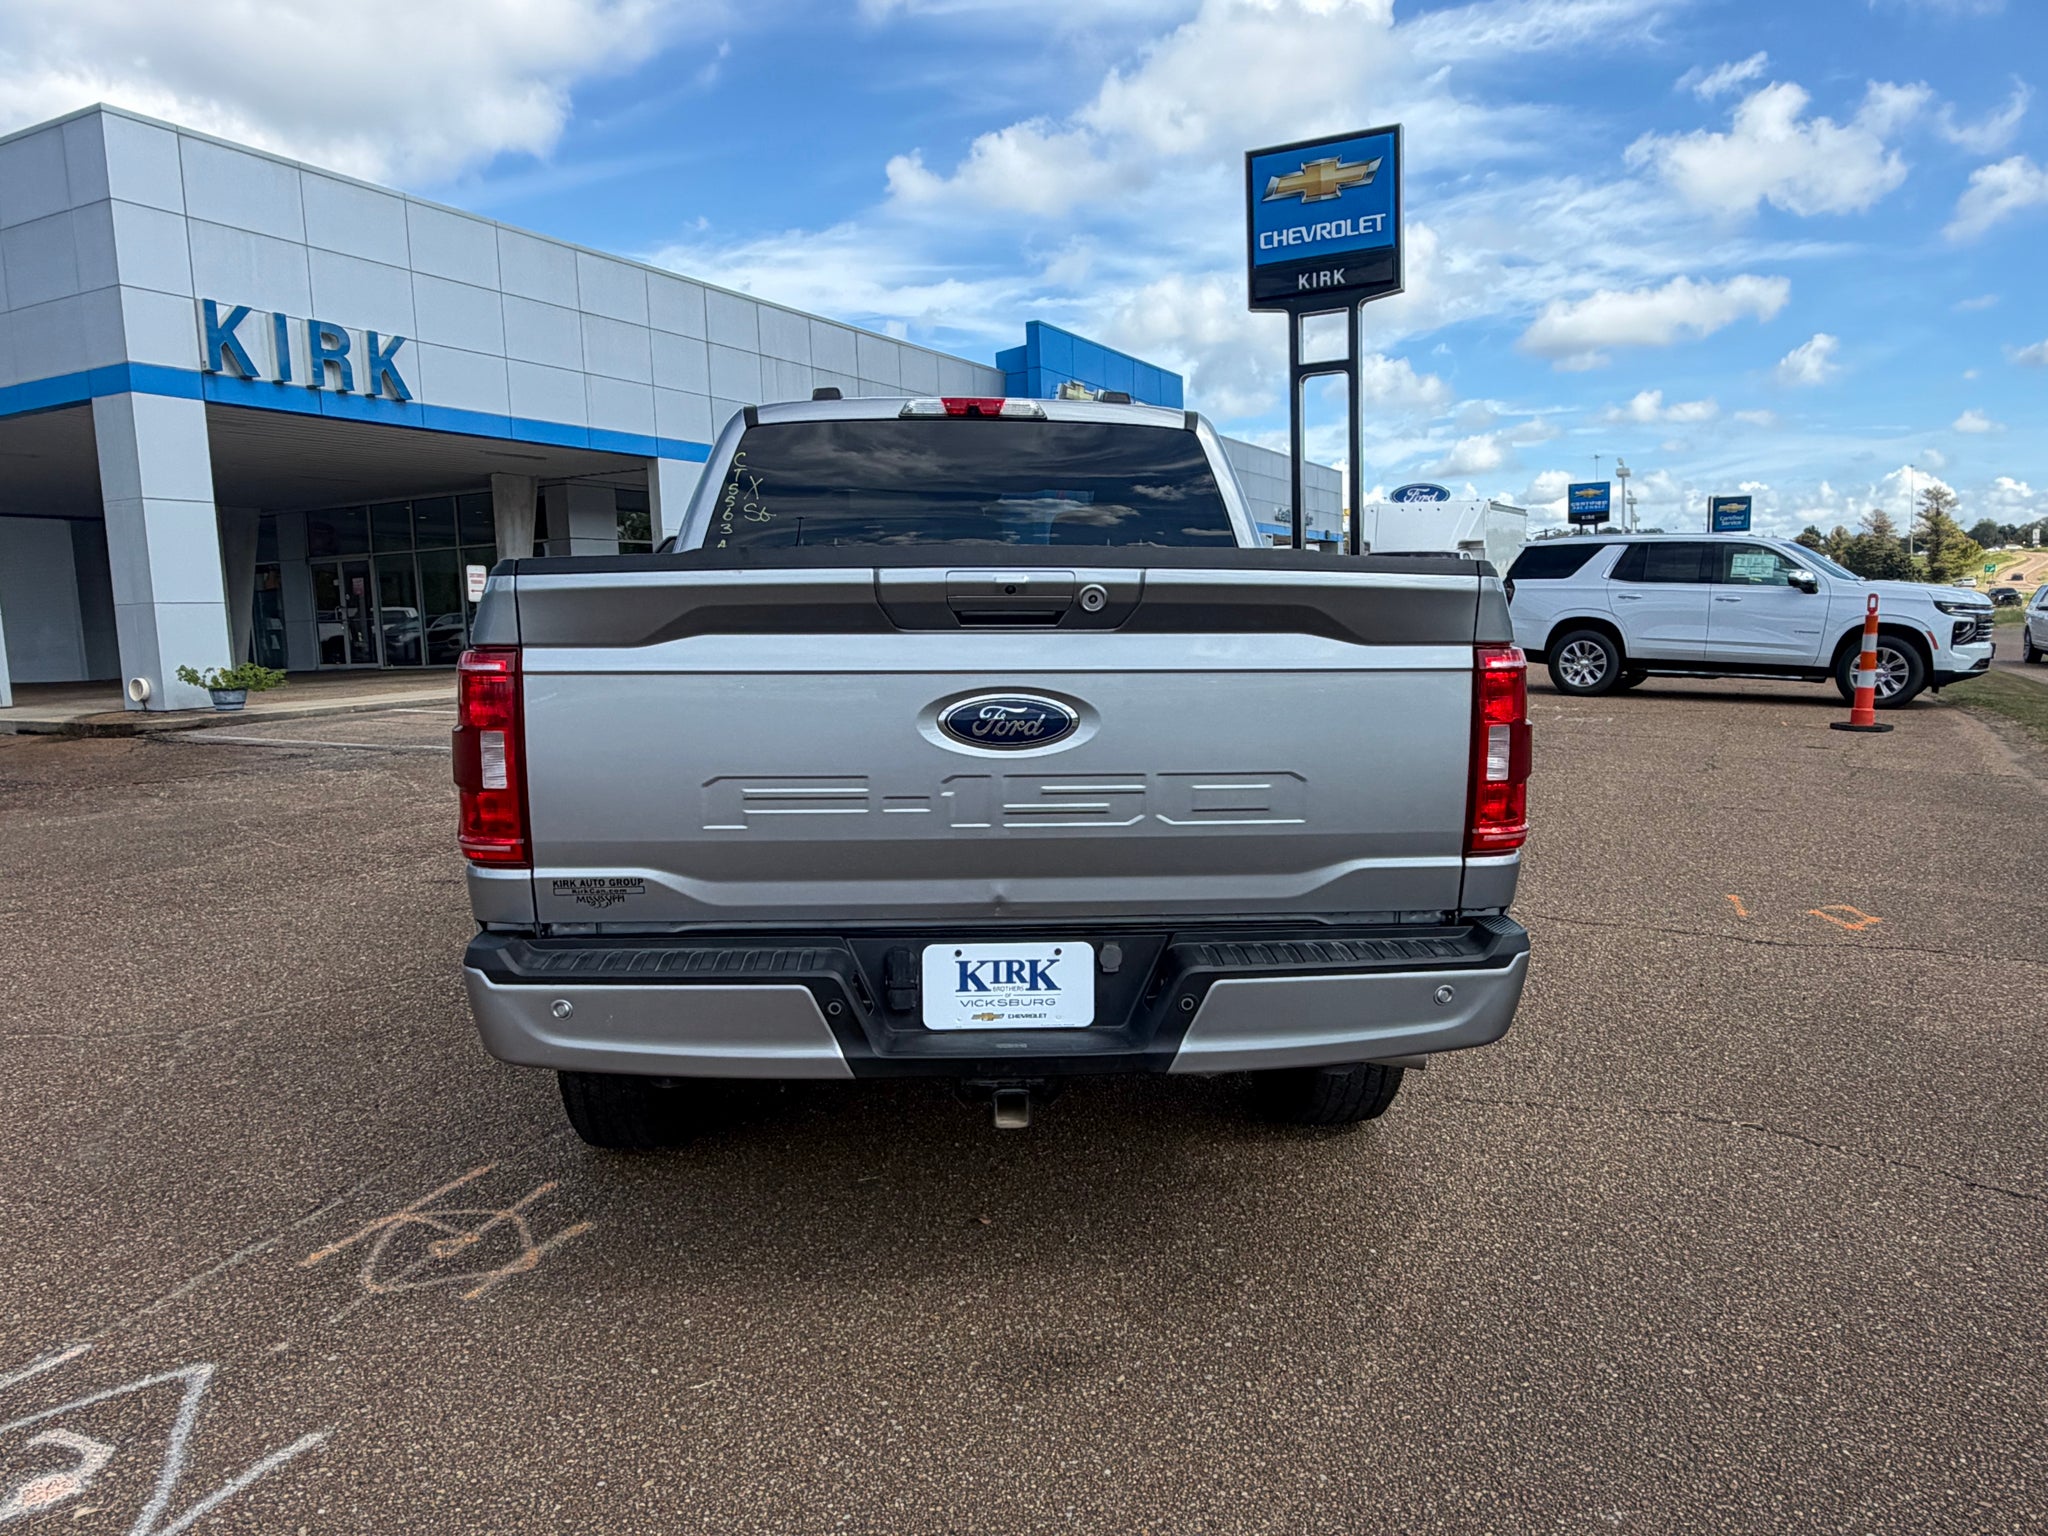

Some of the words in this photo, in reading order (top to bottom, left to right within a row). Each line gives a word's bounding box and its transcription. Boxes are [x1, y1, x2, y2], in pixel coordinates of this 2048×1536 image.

[1259, 213, 1387, 250] CHEVROLET
[1297, 268, 1346, 290] KIRK
[201, 298, 413, 402] KIRK
[1404, 487, 1439, 502] Ford
[972, 705, 1046, 737] Ford
[701, 774, 1308, 830] F-150
[552, 879, 577, 889] KIRK
[580, 878, 605, 888] AUTO
[608, 878, 644, 887] GROUP
[955, 958, 1062, 993] KIRK
[992, 985, 1024, 993] BROTHERS
[960, 998, 1056, 1008] VICKSBURG
